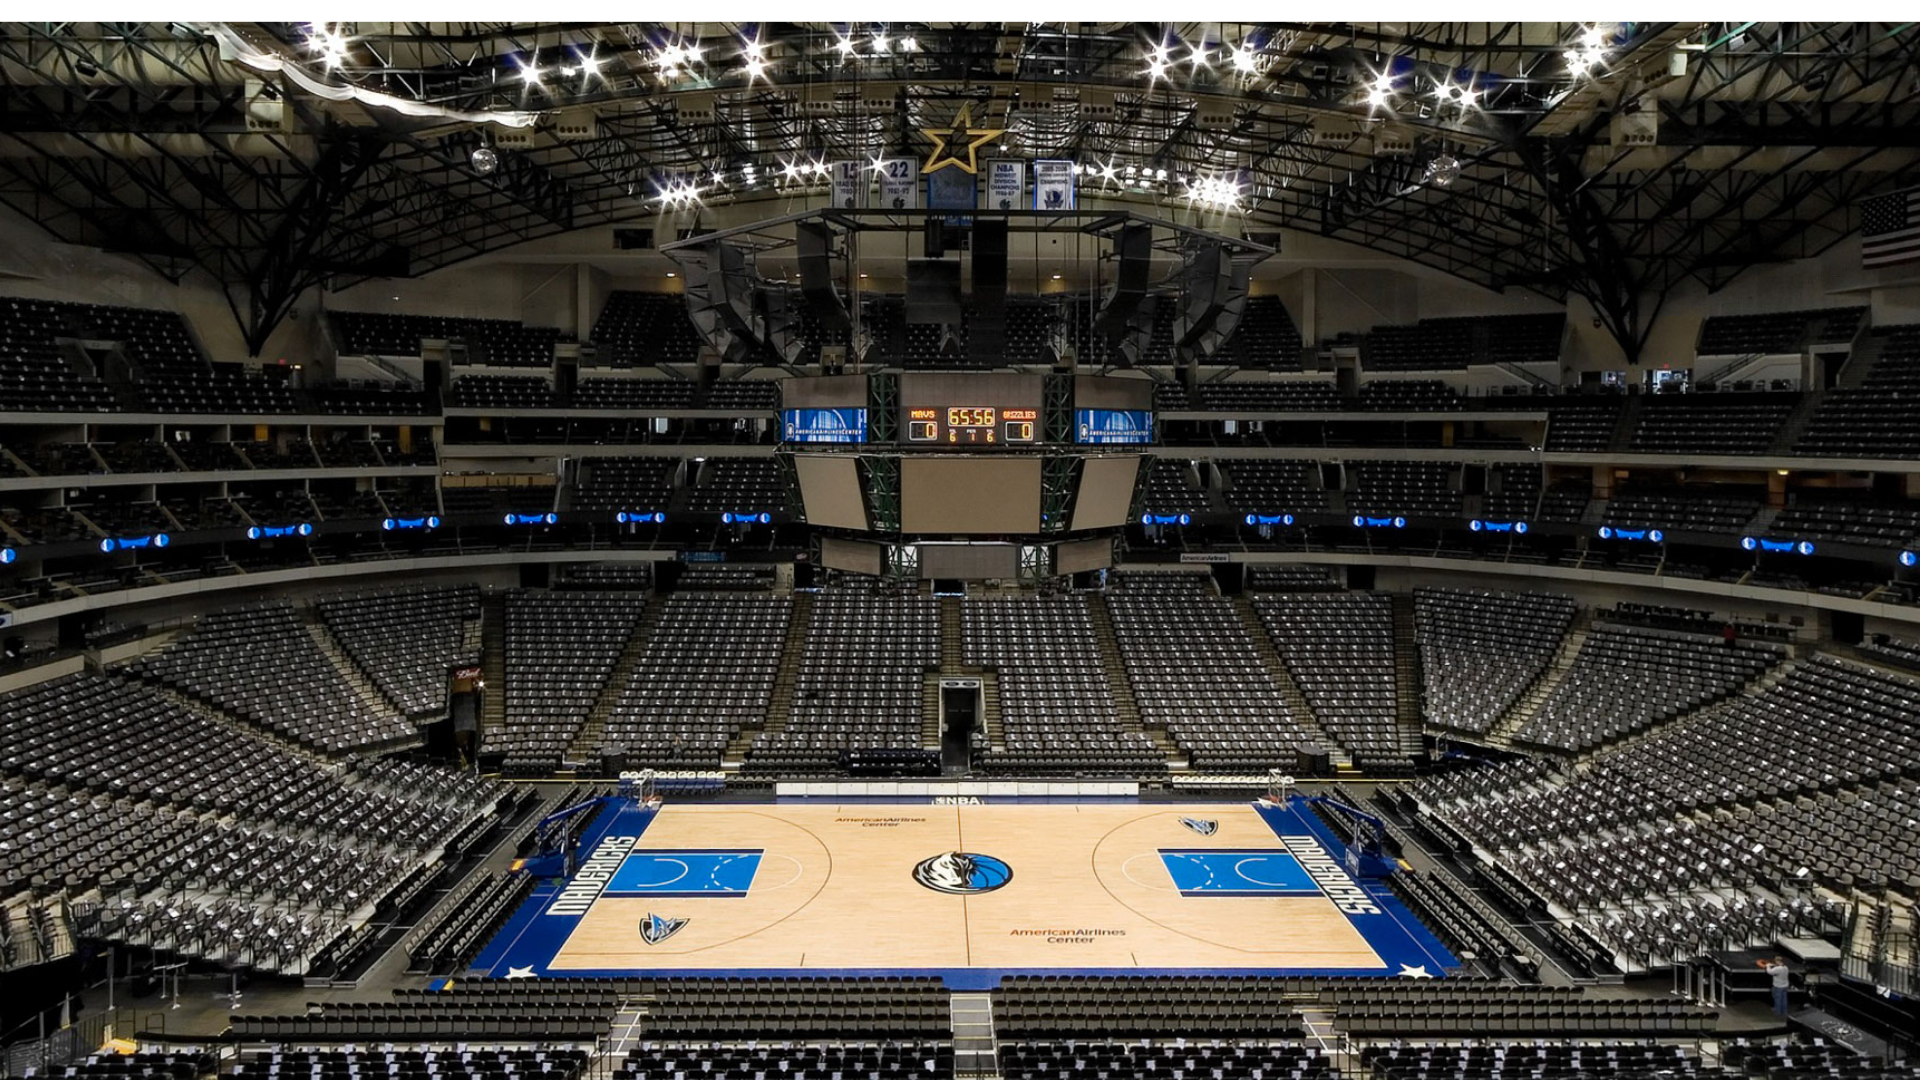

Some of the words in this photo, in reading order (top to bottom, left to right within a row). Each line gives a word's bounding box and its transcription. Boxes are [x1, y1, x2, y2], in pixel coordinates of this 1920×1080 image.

[842, 163, 858, 179] 15
[890, 161, 908, 178] 22
[996, 164, 1014, 172] NBA
[911, 410, 936, 419] MAVS
[949, 408, 994, 425] 65:56
[1002, 410, 1037, 419] GRIZZLIES
[926, 423, 936, 438] 0
[1022, 423, 1032, 438] 0
[949, 432, 956, 442] 6
[986, 432, 994, 442] 6
[946, 796, 980, 805] NBA
[545, 836, 637, 916] MAVERICKS
[1281, 835, 1382, 915] MAVERICKS
[1047, 936, 1096, 944] Center
